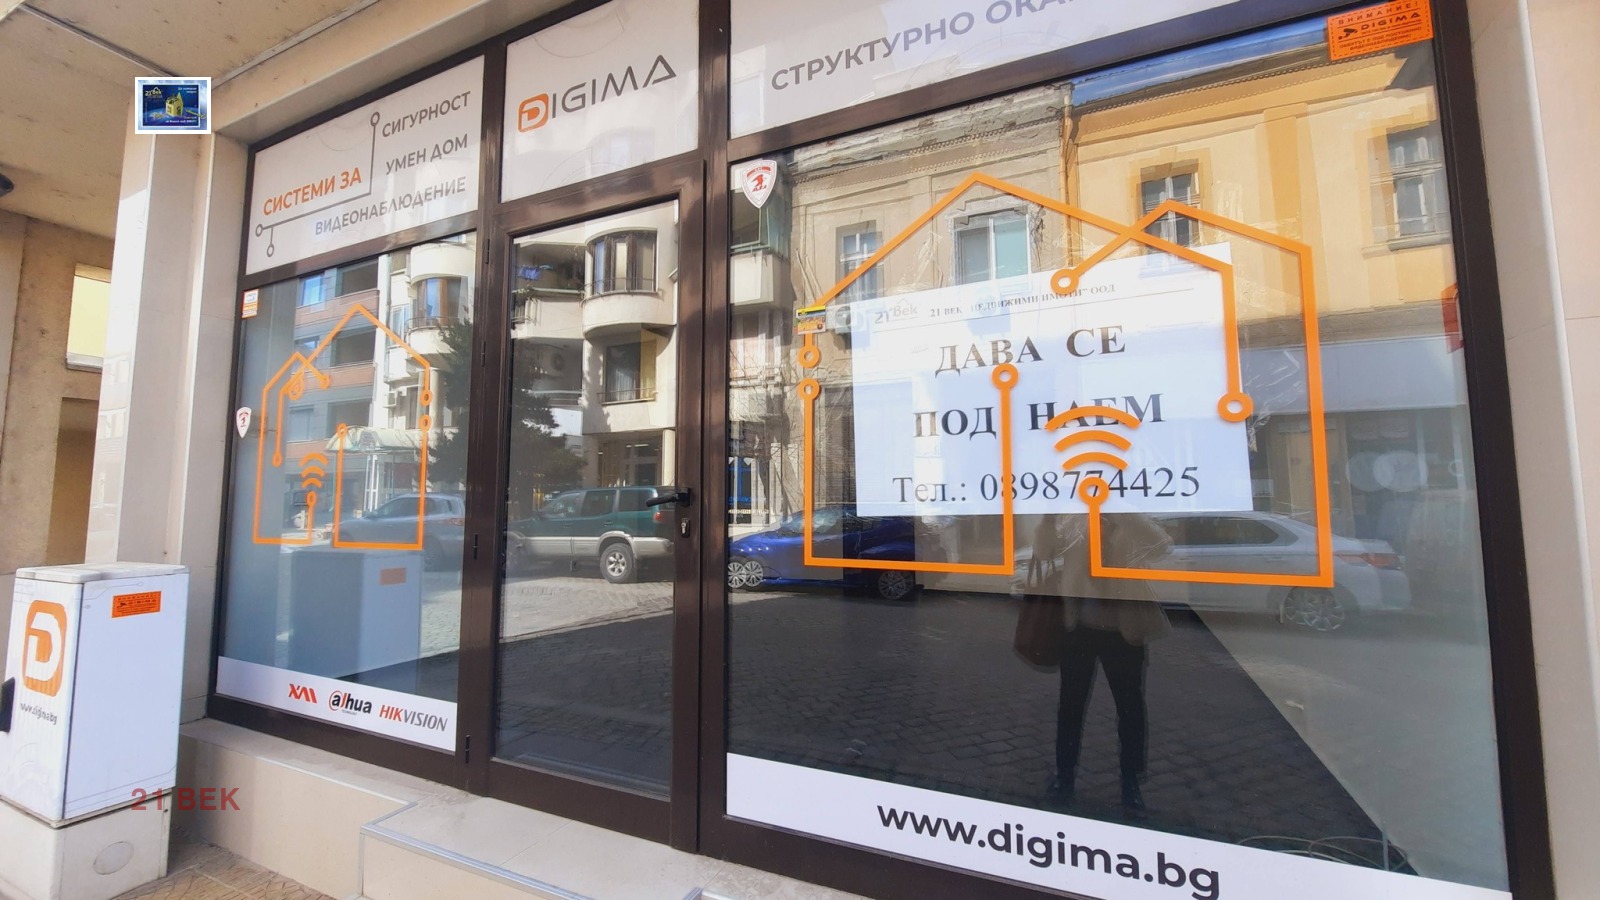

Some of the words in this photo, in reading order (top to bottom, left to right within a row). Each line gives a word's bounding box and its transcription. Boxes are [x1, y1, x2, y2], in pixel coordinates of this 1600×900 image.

[1361, 12, 1420, 30] DIGIMA
[771, 11, 975, 91] СТРУКТУРНО
[382, 91, 471, 138] СИГУРНОСТ
[518, 54, 677, 133] DIGIMA
[386, 148, 426, 176] УМЕН
[430, 133, 468, 163] ДОМ
[263, 175, 336, 216] СИСТЕМИ
[340, 167, 362, 190] ЗА
[315, 176, 467, 236] ВИДЕОНАБЛЮДЕНИЕ
[930, 308, 940, 318] 21
[944, 306, 963, 316] ВЕК
[1091, 284, 1116, 294] ООД
[935, 336, 1043, 379] ДАВА
[1066, 325, 1126, 358] СЕ
[914, 406, 997, 440] ПОД
[1026, 393, 1166, 431] НАЕМ
[892, 476, 967, 503] Тел.:
[379, 705, 449, 732] HIKVISION
[876, 804, 1220, 900] www.digima.bg
